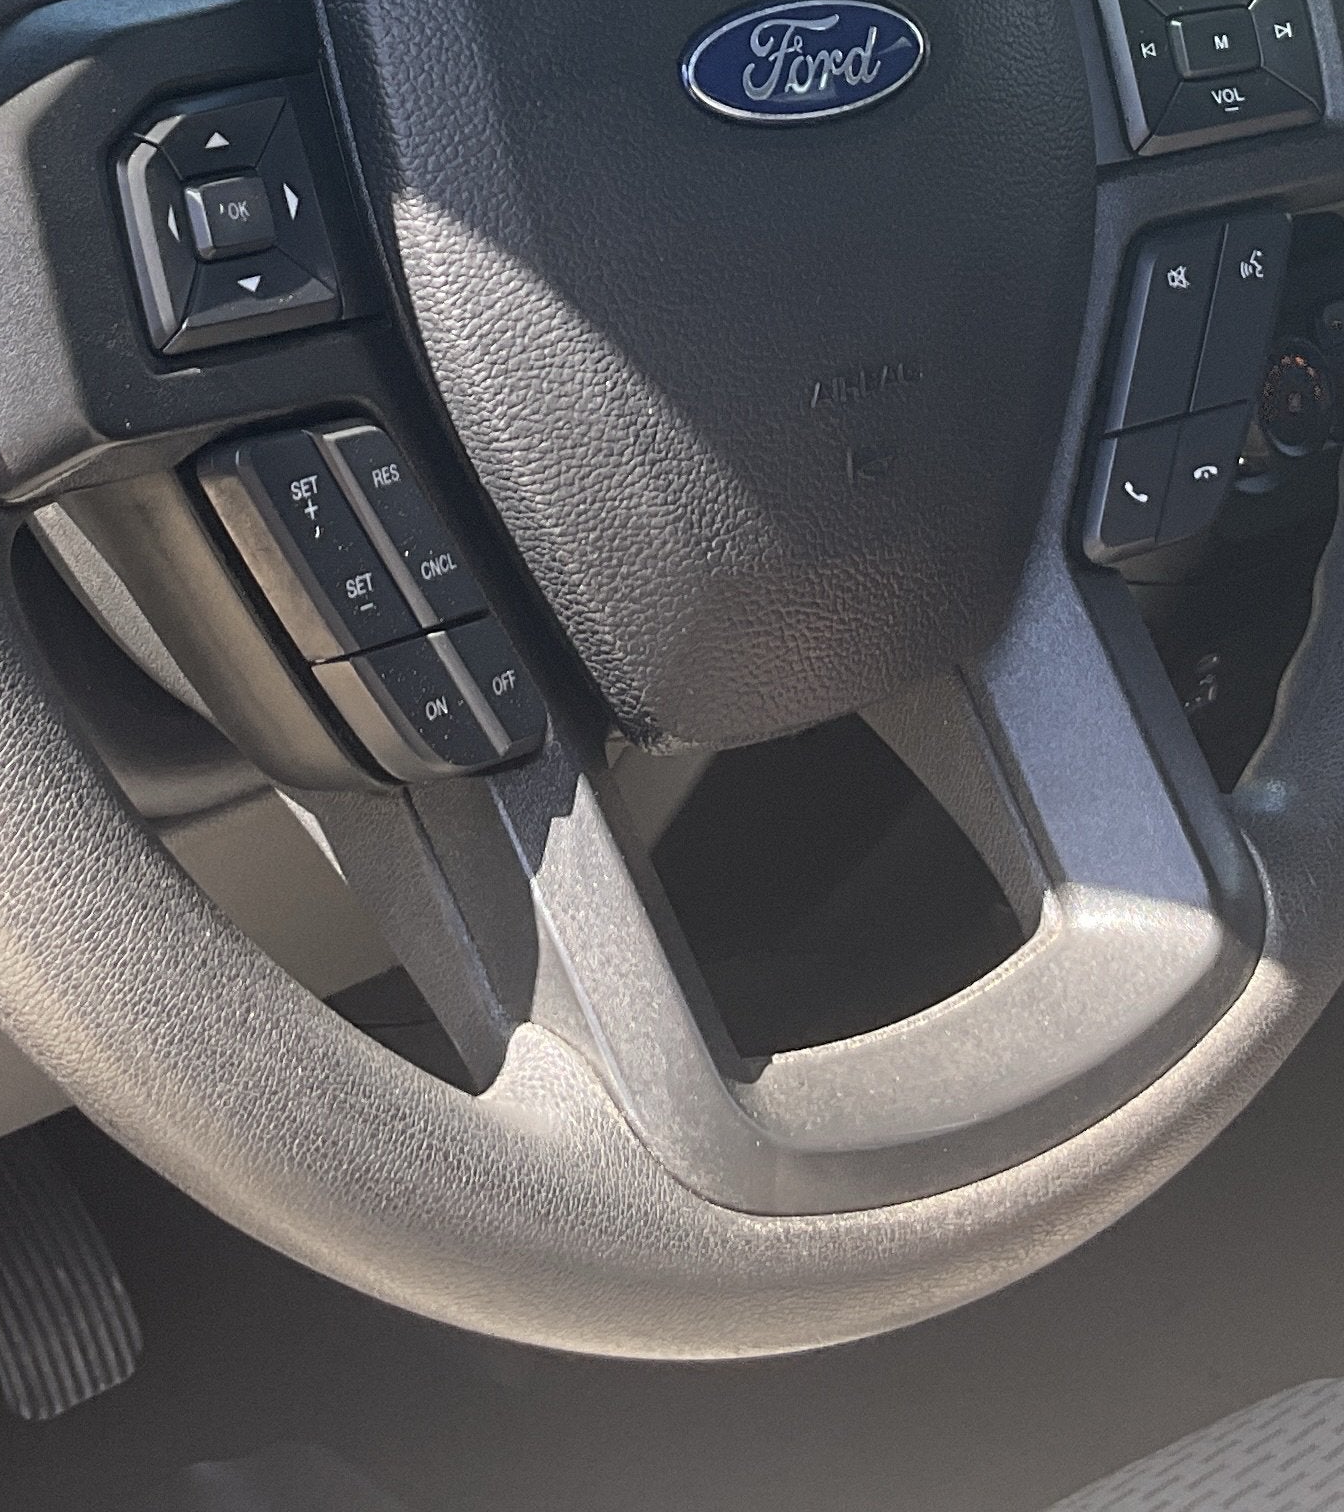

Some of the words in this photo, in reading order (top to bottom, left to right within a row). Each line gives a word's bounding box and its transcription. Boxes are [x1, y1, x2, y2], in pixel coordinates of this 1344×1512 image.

[1213, 34, 1229, 50] M
[742, 13, 882, 101] Ford
[1210, 87, 1246, 105] VOL
[228, 200, 251, 220] OK
[290, 475, 319, 501] SET
[372, 464, 400, 488] RES
[420, 553, 458, 581] CNCL
[345, 572, 374, 599] SET
[492, 670, 517, 696] OFF
[425, 696, 449, 721] ON
